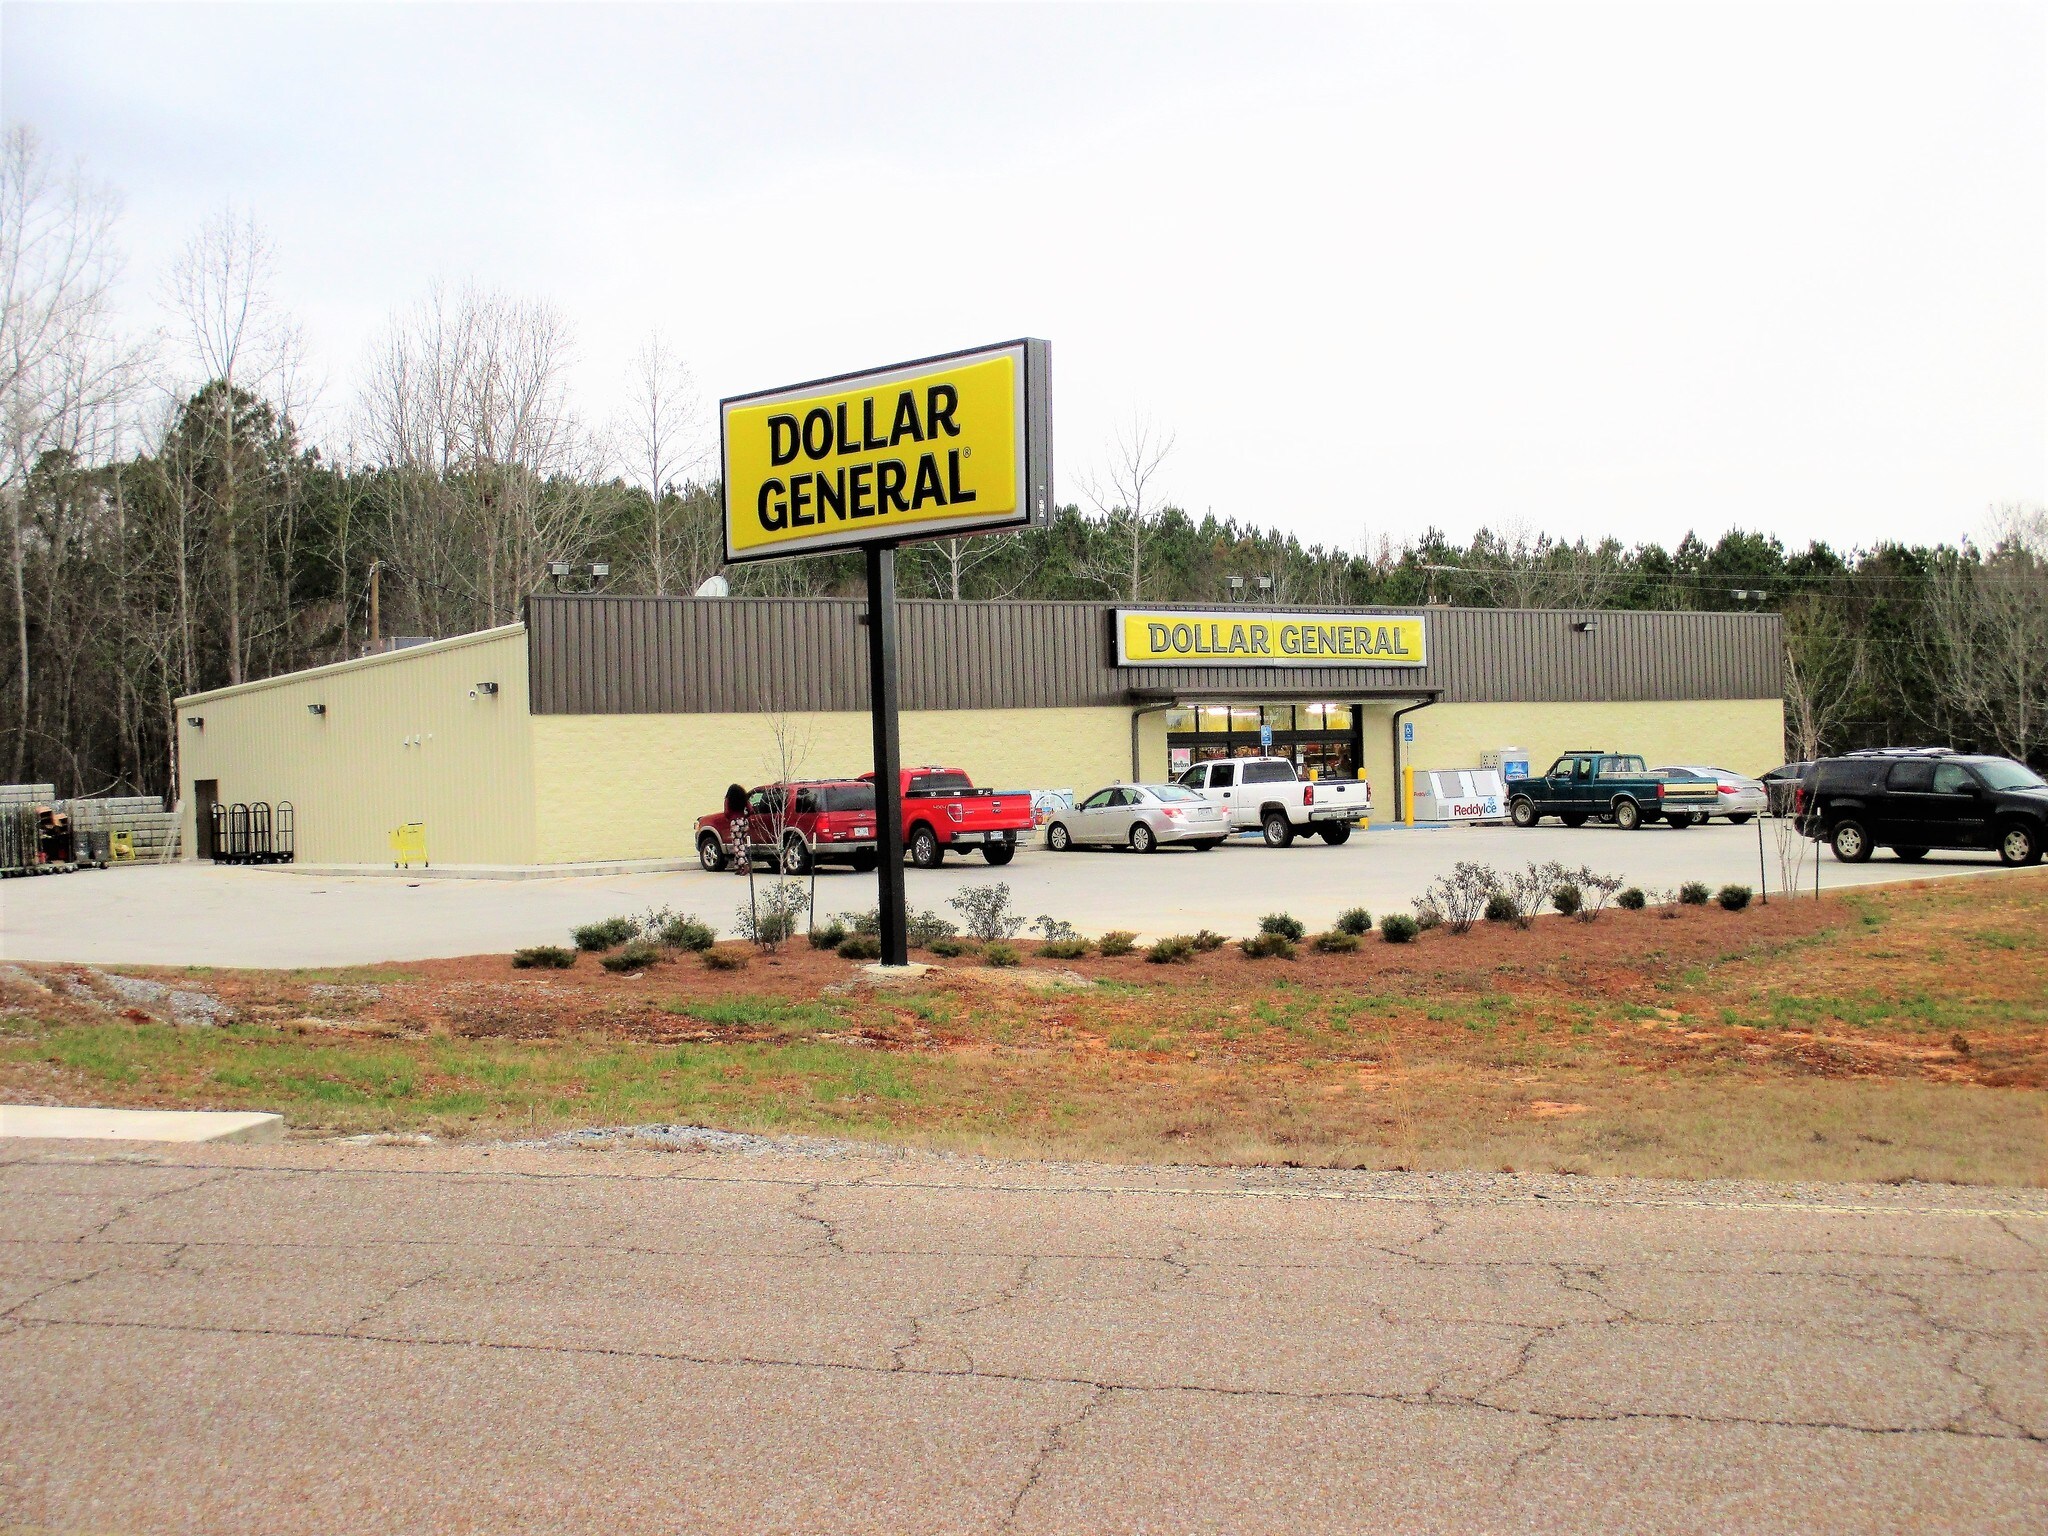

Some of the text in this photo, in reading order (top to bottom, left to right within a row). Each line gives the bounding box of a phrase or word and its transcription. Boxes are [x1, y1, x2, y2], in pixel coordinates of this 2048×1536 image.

[768, 382, 961, 467] DOLLAR
[757, 447, 977, 532] GENERAL
[1148, 623, 1409, 655] DOLLAR GENERAL
